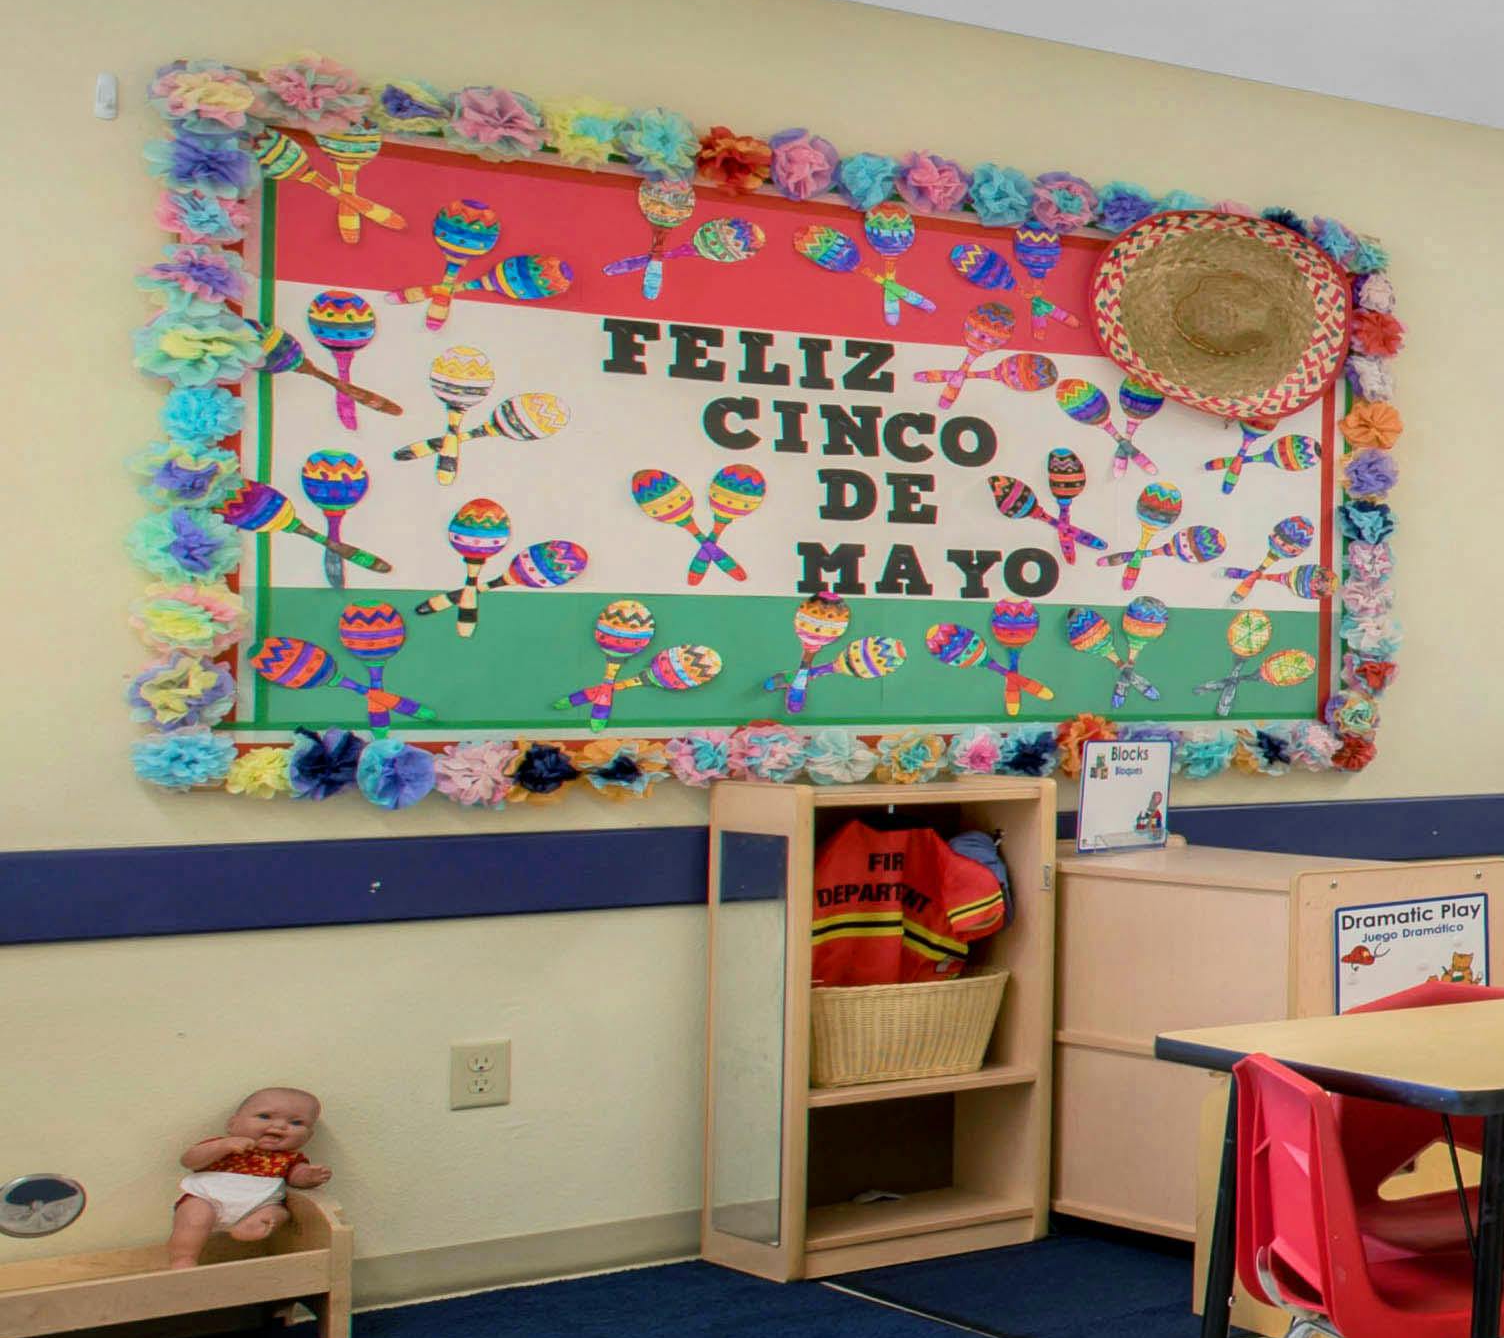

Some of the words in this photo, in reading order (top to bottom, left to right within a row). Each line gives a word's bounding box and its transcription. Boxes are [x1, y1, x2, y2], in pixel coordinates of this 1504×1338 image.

[602, 317, 896, 393] FELIZ
[702, 396, 998, 468] CINCO
[817, 468, 938, 525] DE
[797, 540, 1060, 599] MAYO
[1111, 746, 1150, 761] Blocks
[868, 852, 905, 873] FIR
[1341, 906, 1434, 930] Dramatic
[1441, 902, 1482, 919] Play
[1361, 931, 1398, 943] Juego
[1402, 923, 1464, 939] Dramático
